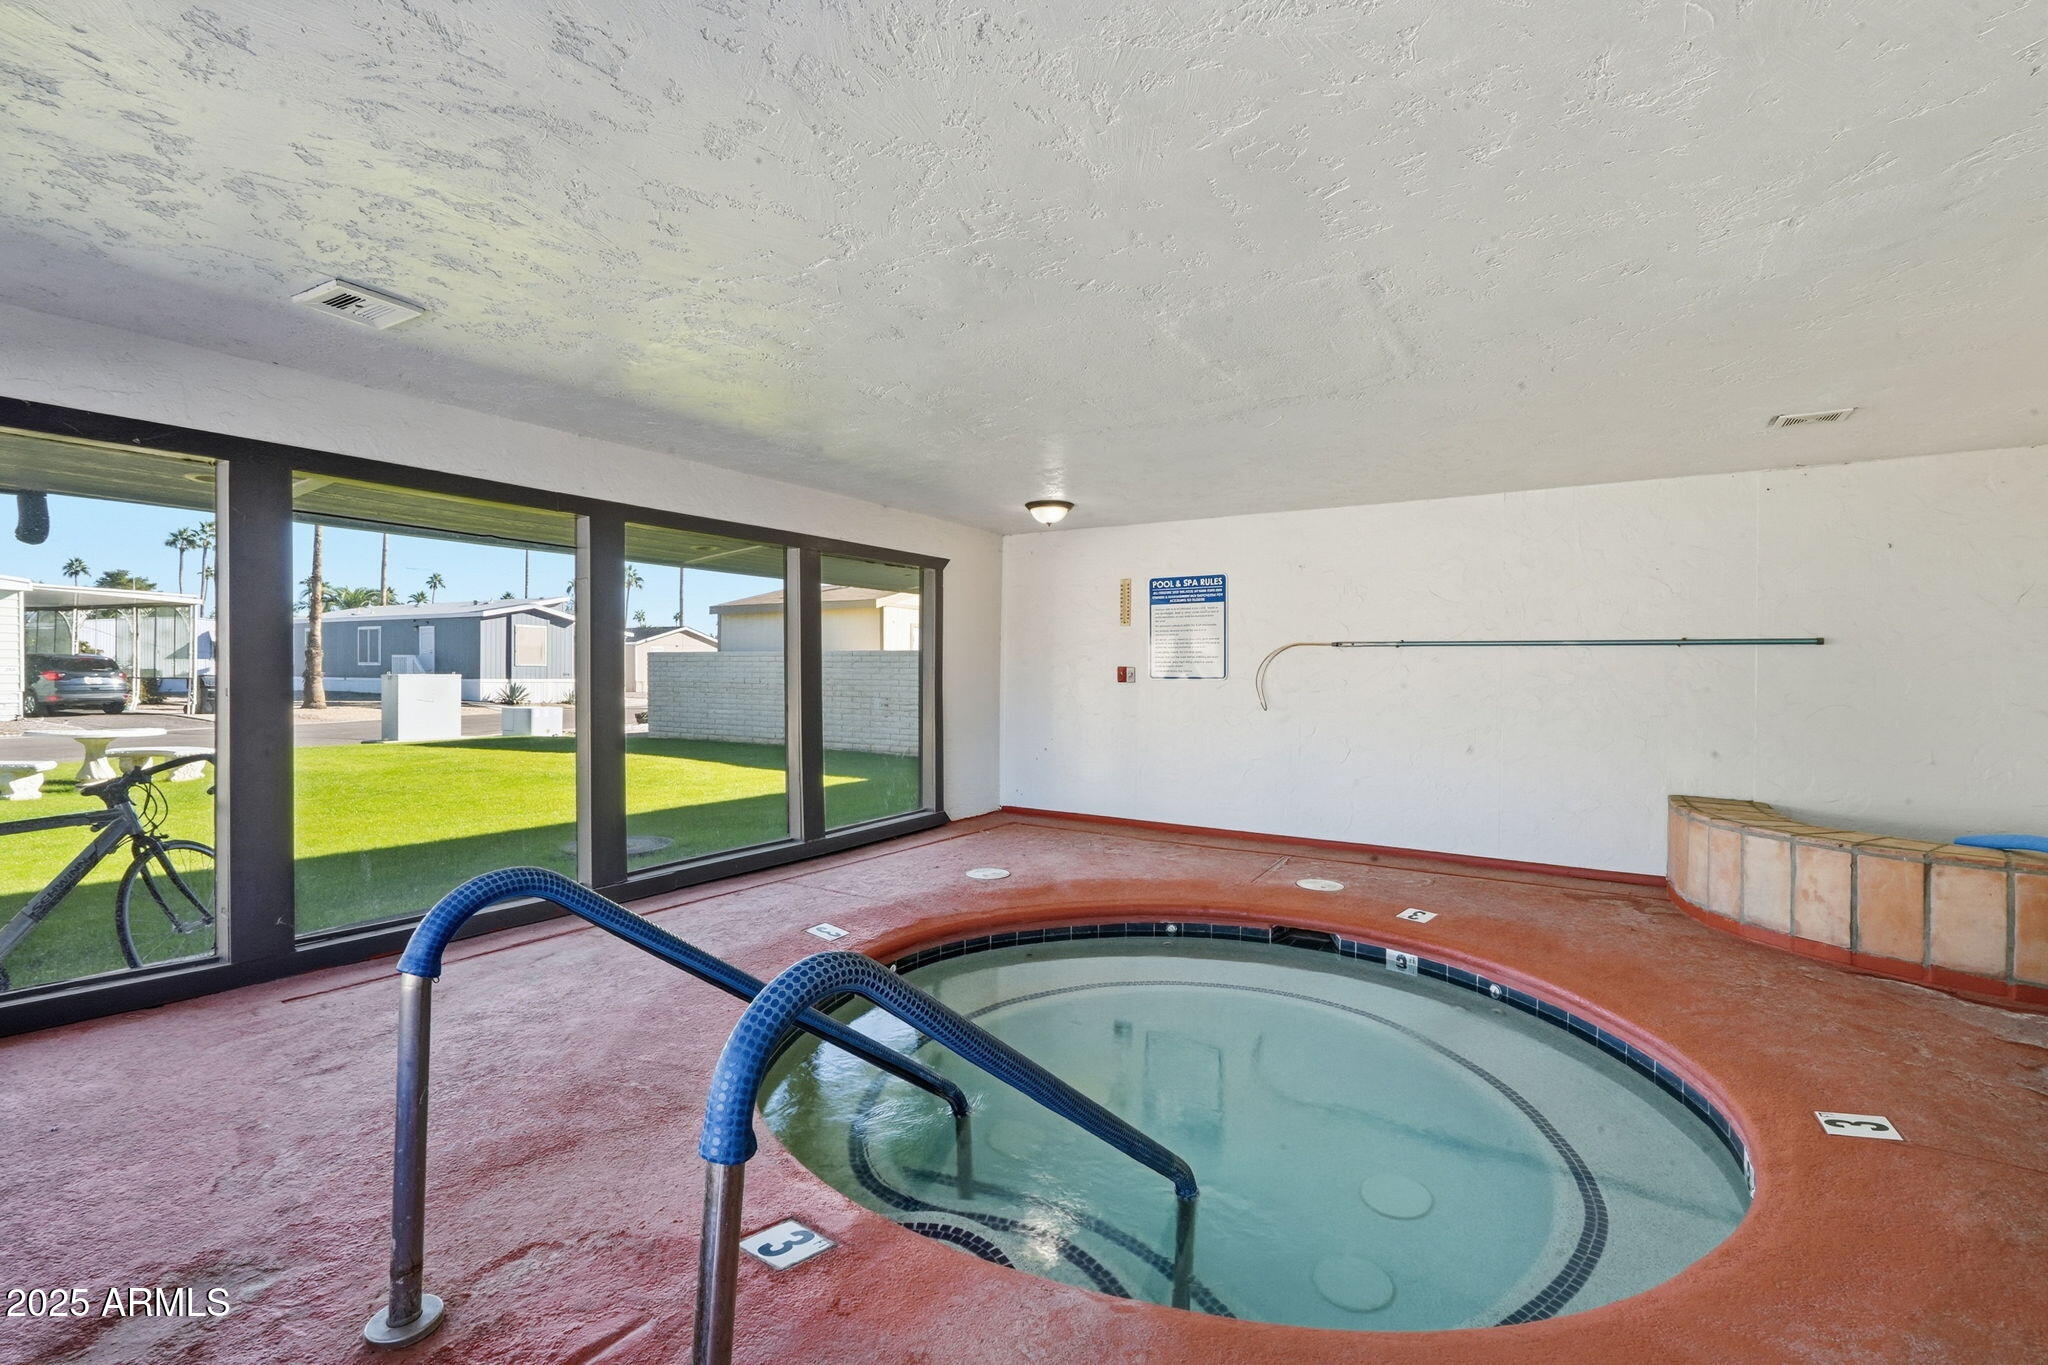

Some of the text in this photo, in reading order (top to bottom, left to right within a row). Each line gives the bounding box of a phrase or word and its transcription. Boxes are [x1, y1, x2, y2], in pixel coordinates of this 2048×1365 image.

[1152, 577, 1223, 589] POOL & SPA RULES
[1407, 911, 1426, 919] 3
[815, 926, 842, 937] 3
[1823, 1119, 1890, 1132] 3
[757, 1229, 816, 1257] 3
